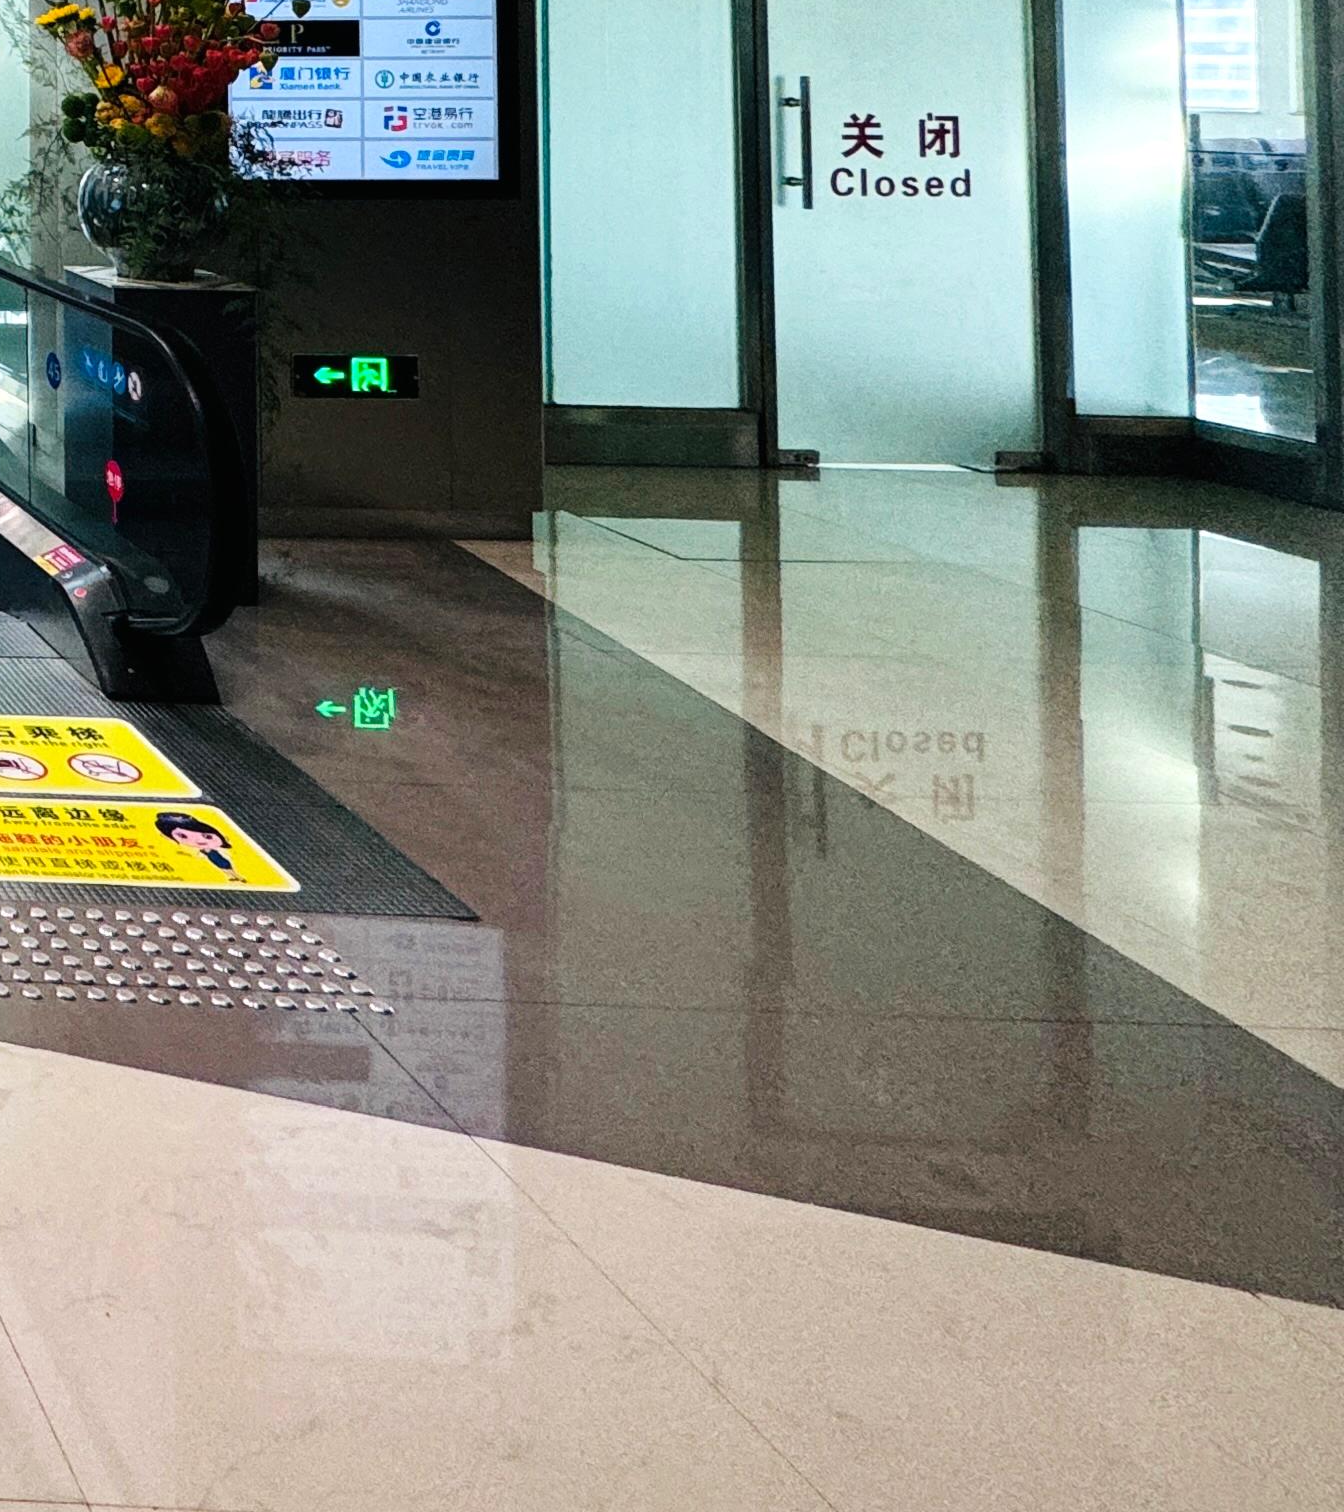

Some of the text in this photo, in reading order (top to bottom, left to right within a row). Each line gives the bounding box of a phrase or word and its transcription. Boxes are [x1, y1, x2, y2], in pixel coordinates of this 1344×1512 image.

[280, 67, 350, 80] 厦门银行
[413, 108, 473, 120] 空港易行
[841, 113, 960, 158] 关闭
[830, 167, 971, 197] Closed
[43, 739, 68, 747] the
[72, 740, 109, 749] right
